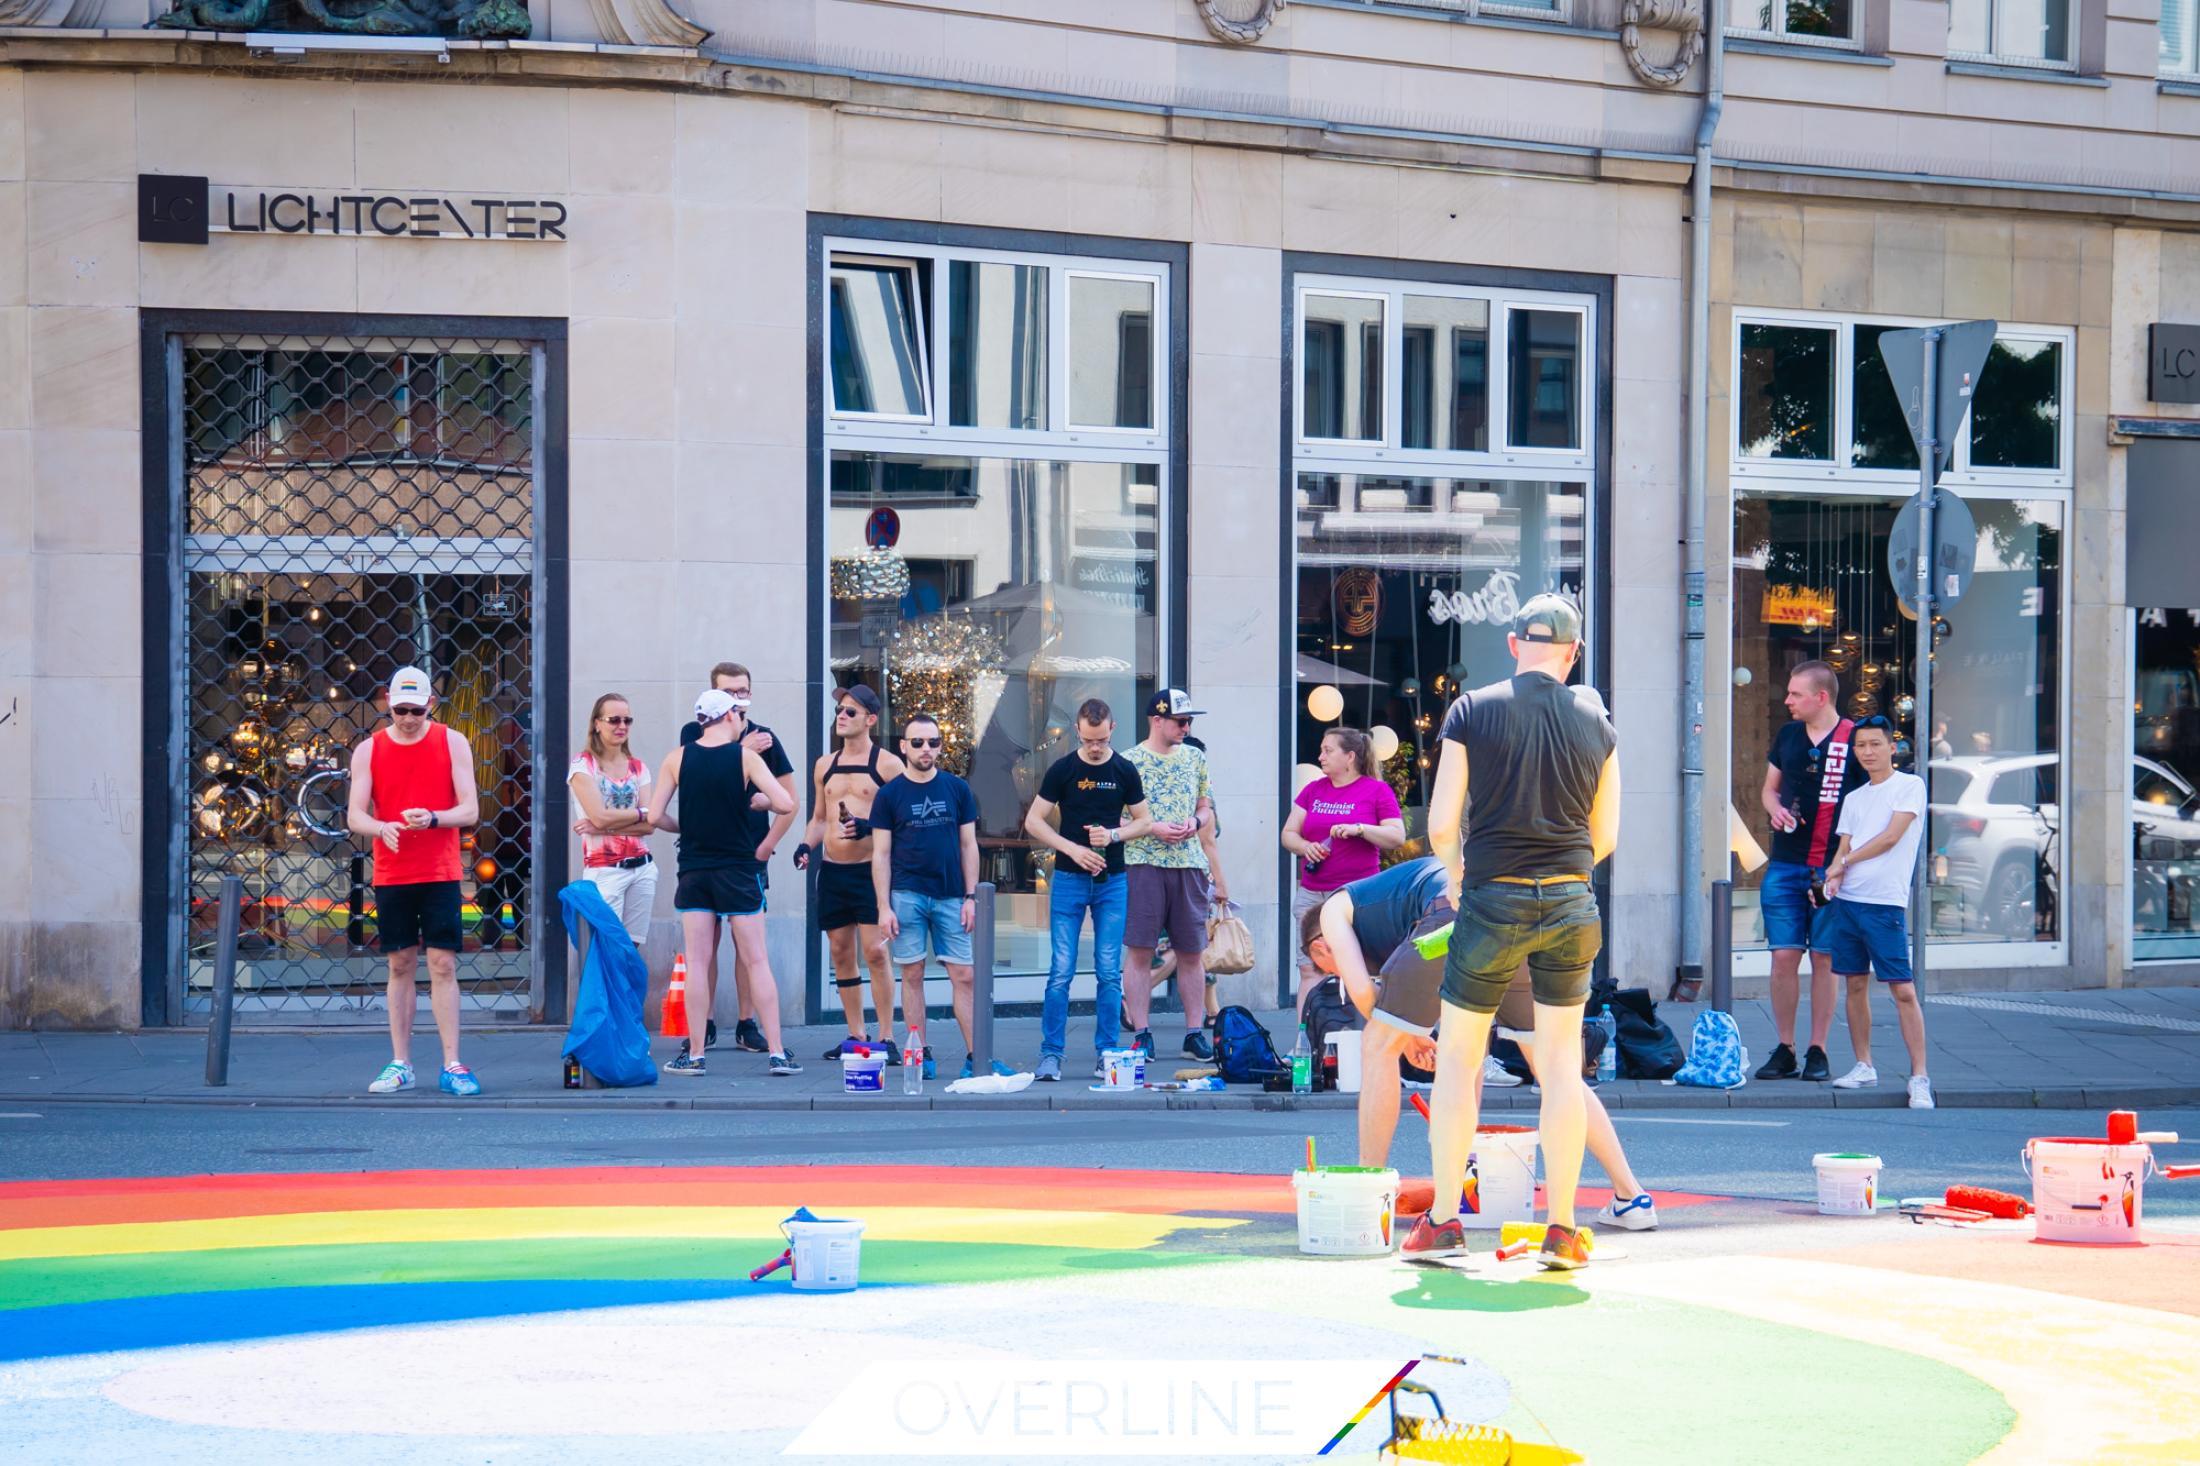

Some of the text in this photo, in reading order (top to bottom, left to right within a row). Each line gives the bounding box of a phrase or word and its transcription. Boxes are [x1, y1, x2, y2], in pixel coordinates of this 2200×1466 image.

[227, 192, 567, 239] LICHTCENTER
[2163, 347, 2196, 379] LC
[1312, 799, 1355, 809] Feminist
